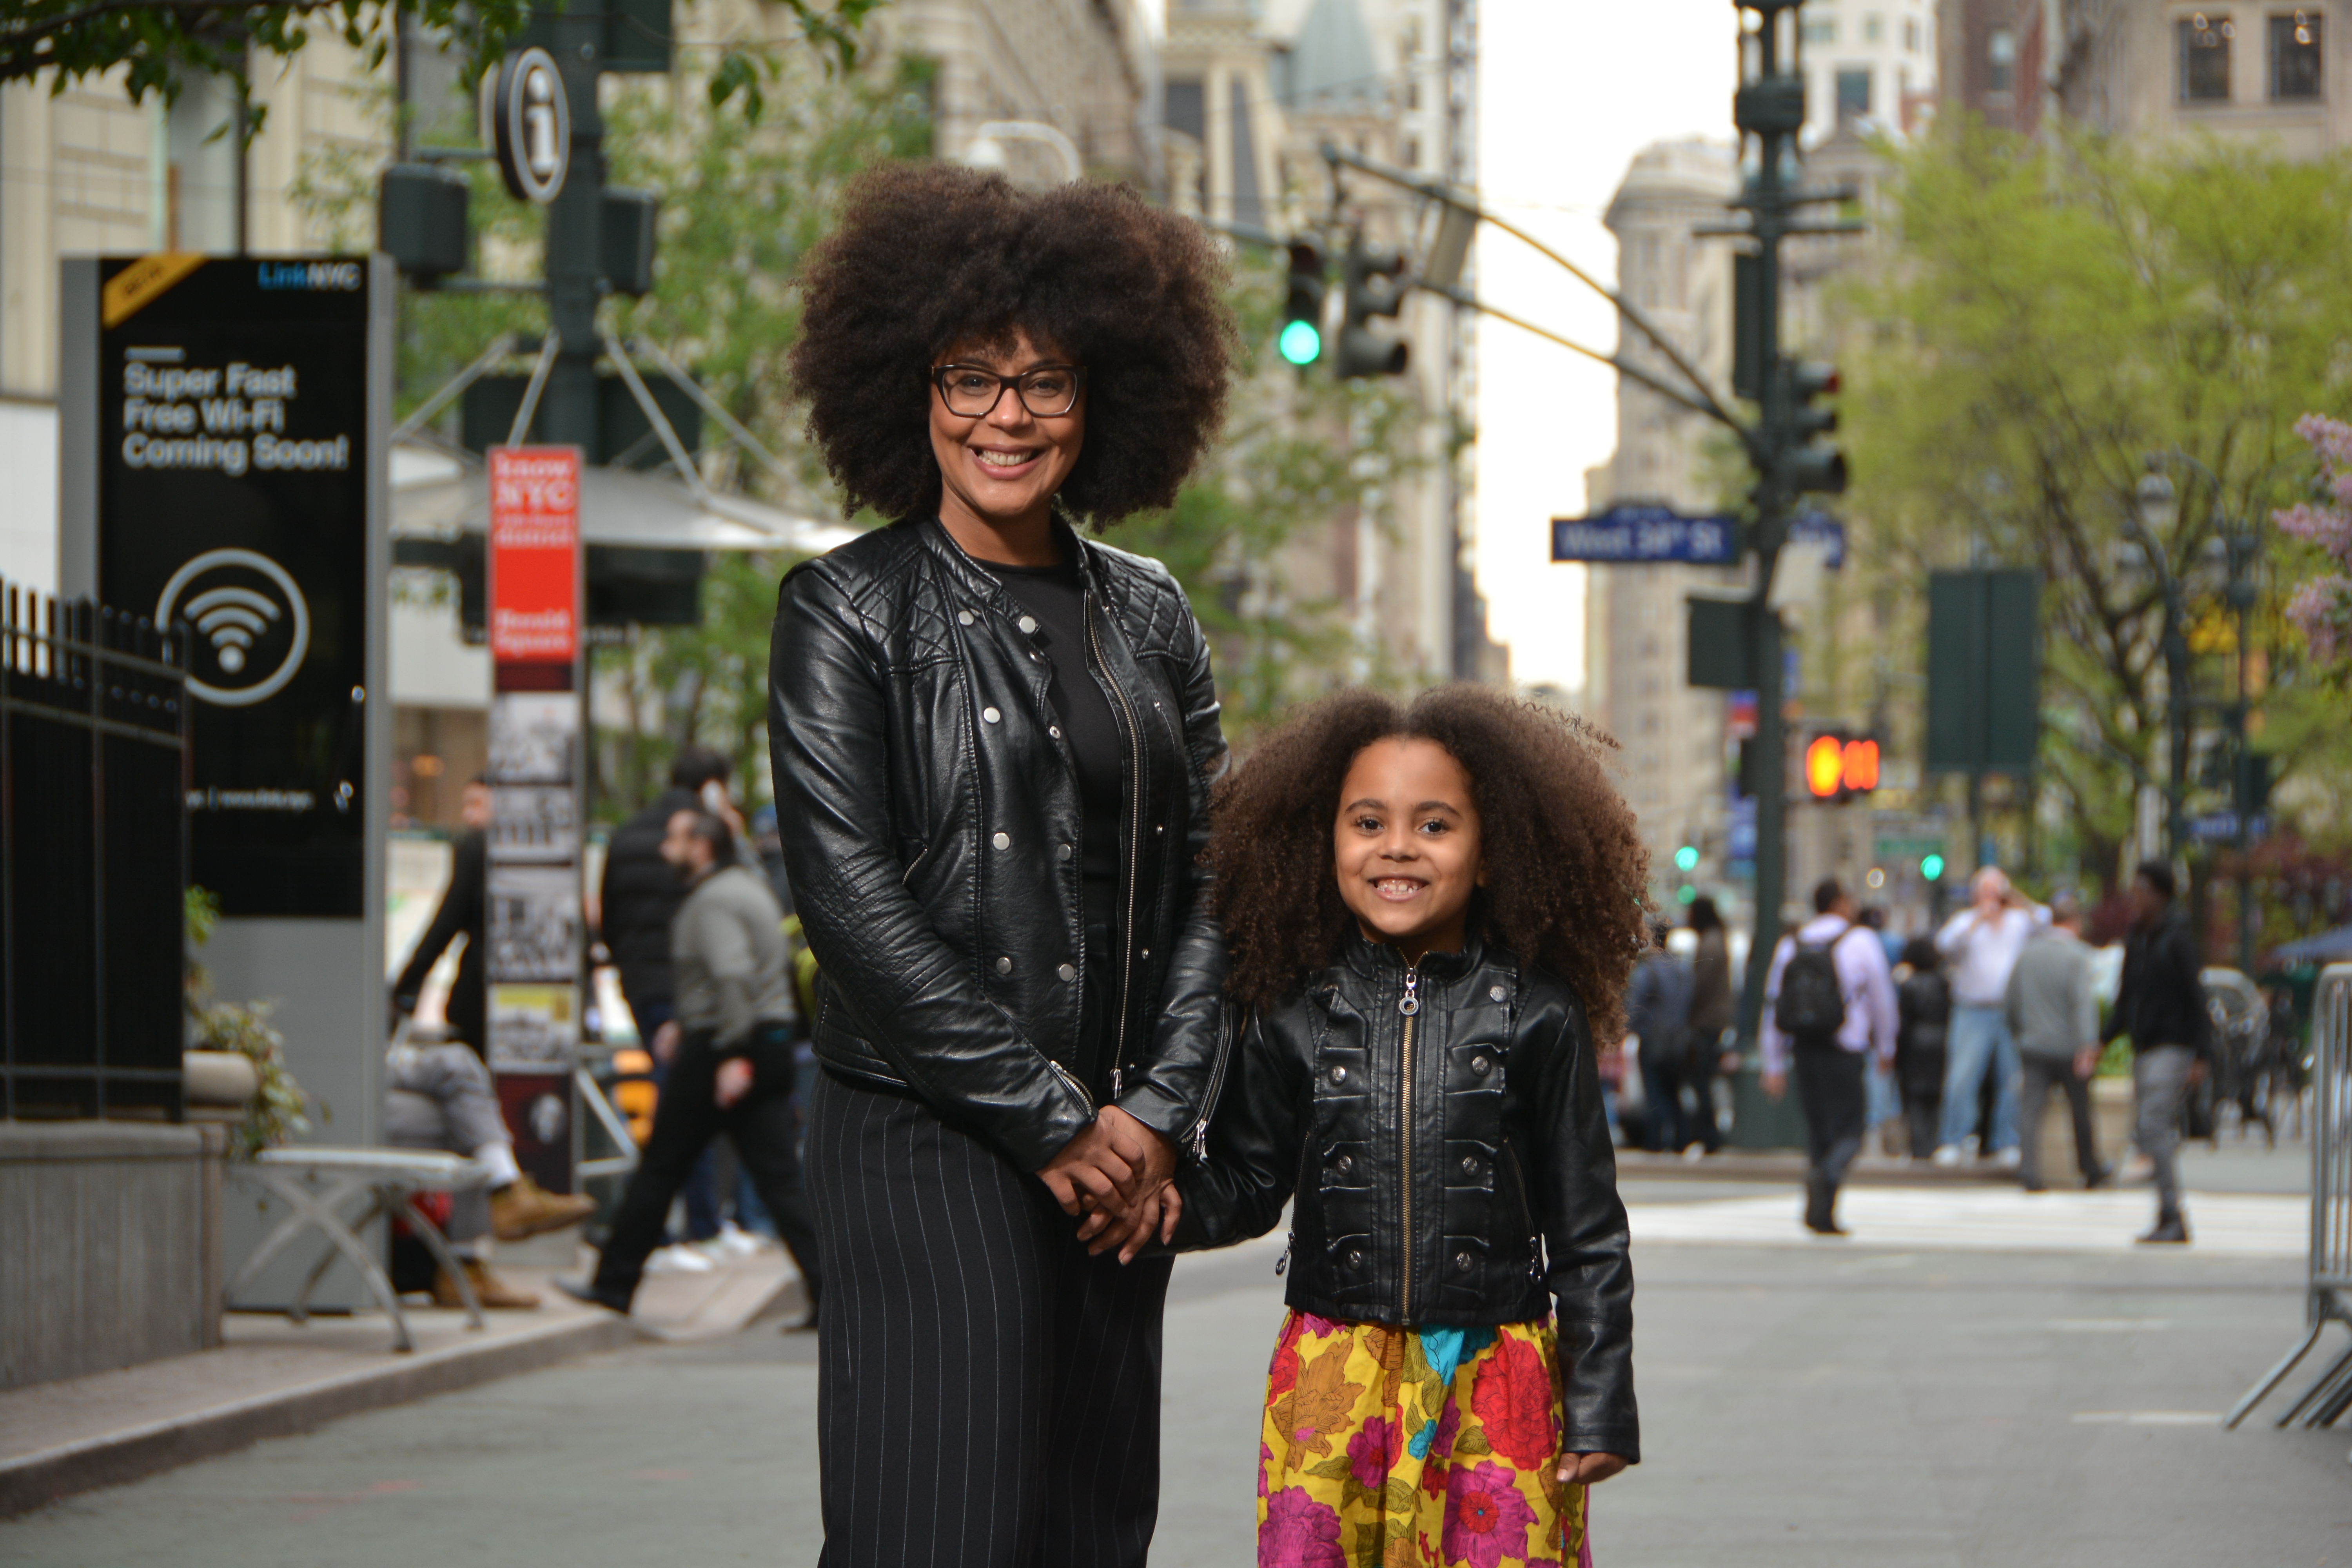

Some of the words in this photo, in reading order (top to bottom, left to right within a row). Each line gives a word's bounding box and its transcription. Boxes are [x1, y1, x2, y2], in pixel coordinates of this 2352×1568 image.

[258, 262, 361, 290] LinkNYC
[125, 362, 219, 400] Super
[227, 364, 296, 398] Fast
[125, 398, 196, 432] Free
[202, 398, 284, 432] Wi-Fi
[123, 433, 247, 475] Coming
[253, 432, 350, 470] Soon!
[495, 479, 576, 512] NYC
[1559, 524, 1632, 555] West
[1688, 521, 1722, 559] St
